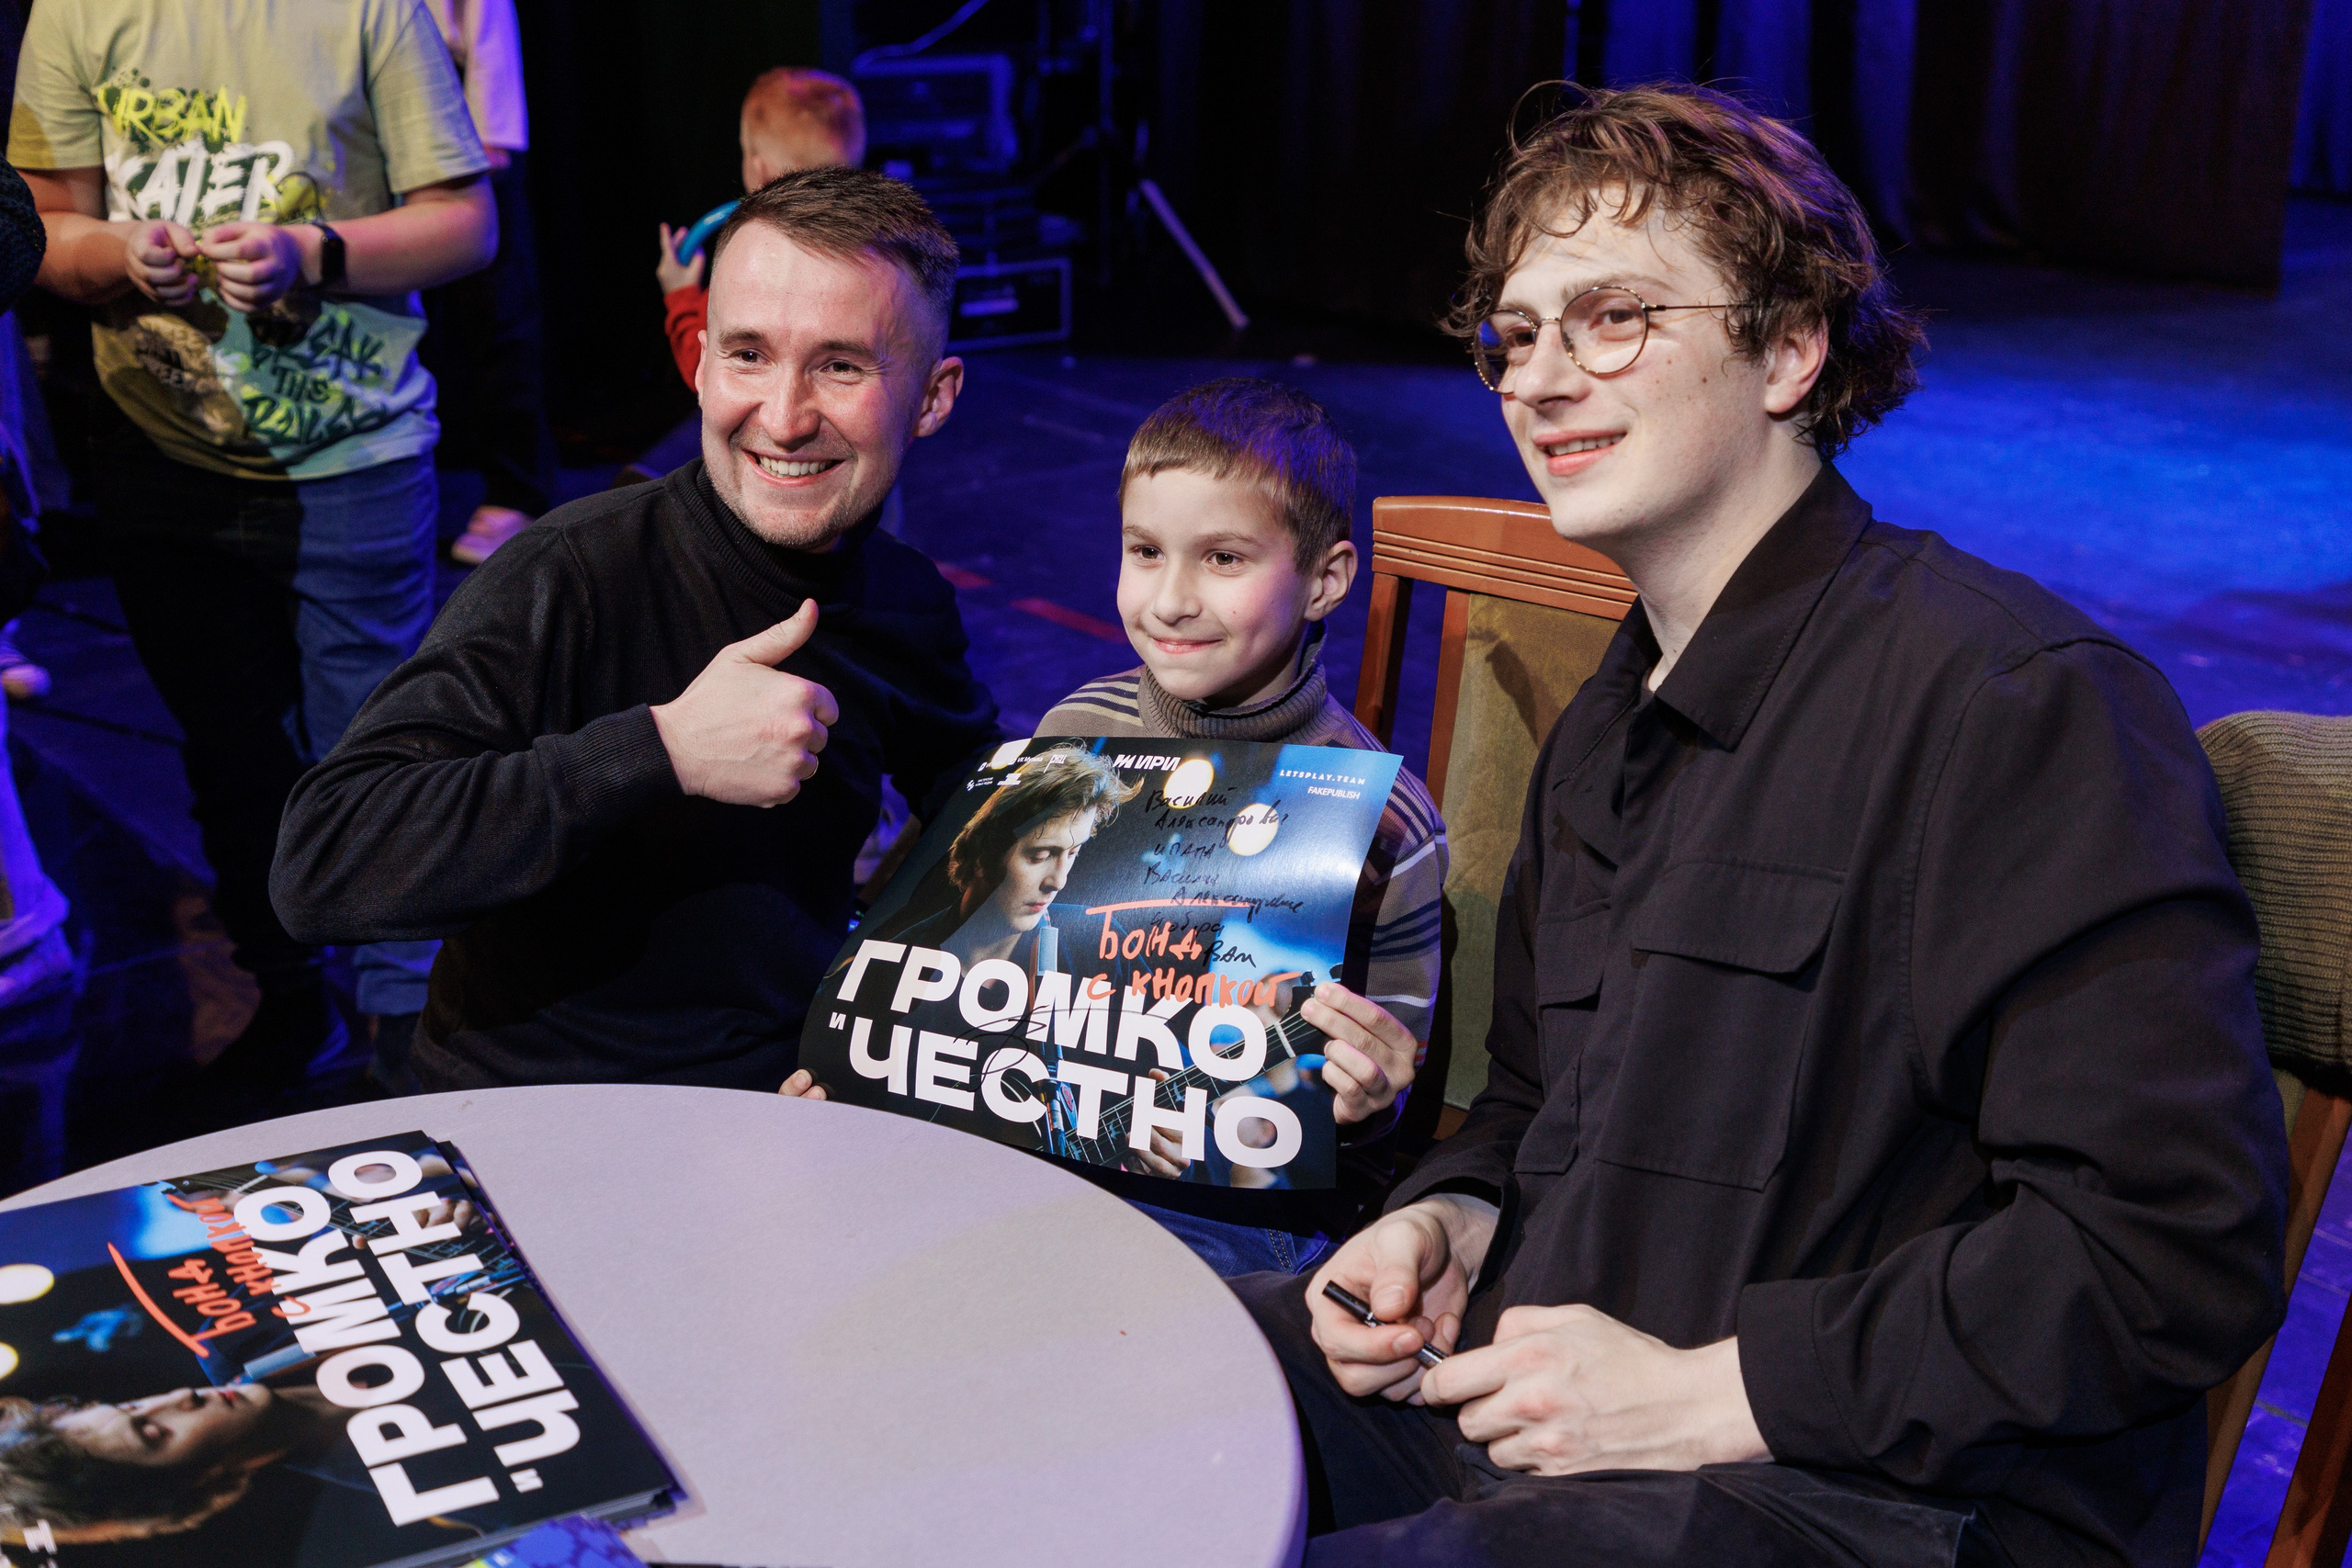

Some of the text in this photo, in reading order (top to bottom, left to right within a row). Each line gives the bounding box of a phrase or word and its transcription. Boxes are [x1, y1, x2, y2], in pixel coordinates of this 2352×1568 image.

[97, 85, 247, 146] URBAN
[1279, 769, 1366, 785] LETSPLAY.TEAM
[1307, 785, 1361, 800] FAKEPUBLISH
[837, 939, 1267, 1081] ГРОМКО
[849, 1018, 1303, 1168] ЧЕСТНО
[234, 1185, 501, 1527] ГРОМКО
[328, 1150, 581, 1468] ЧЕСТНО
